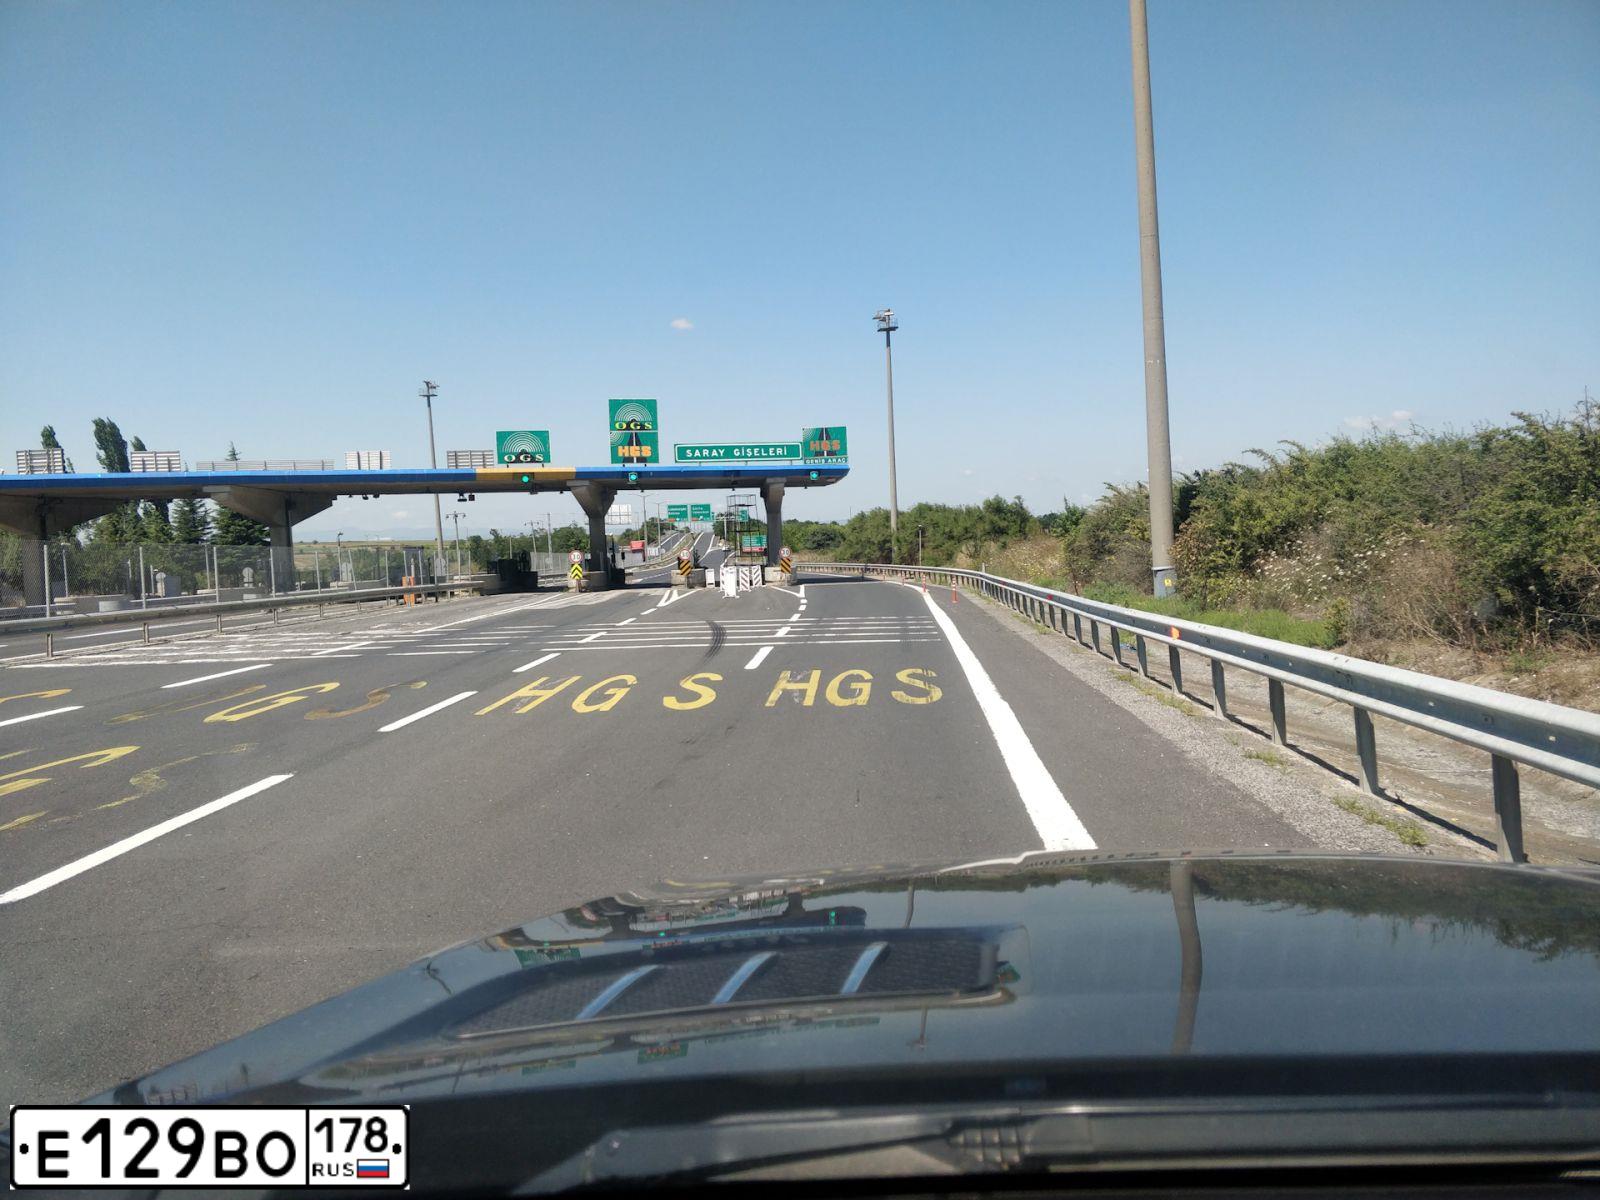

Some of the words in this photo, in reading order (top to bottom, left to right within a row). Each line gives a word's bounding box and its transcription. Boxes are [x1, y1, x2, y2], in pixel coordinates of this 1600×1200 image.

[615, 421, 653, 430] OGS
[617, 445, 653, 457] HGS
[809, 440, 841, 451] HGS
[503, 453, 545, 463] OGS
[685, 448, 726, 458] SARAY
[733, 446, 788, 458] GİŞELERİ
[765, 668, 943, 707] HGS
[474, 673, 723, 716] HGS
